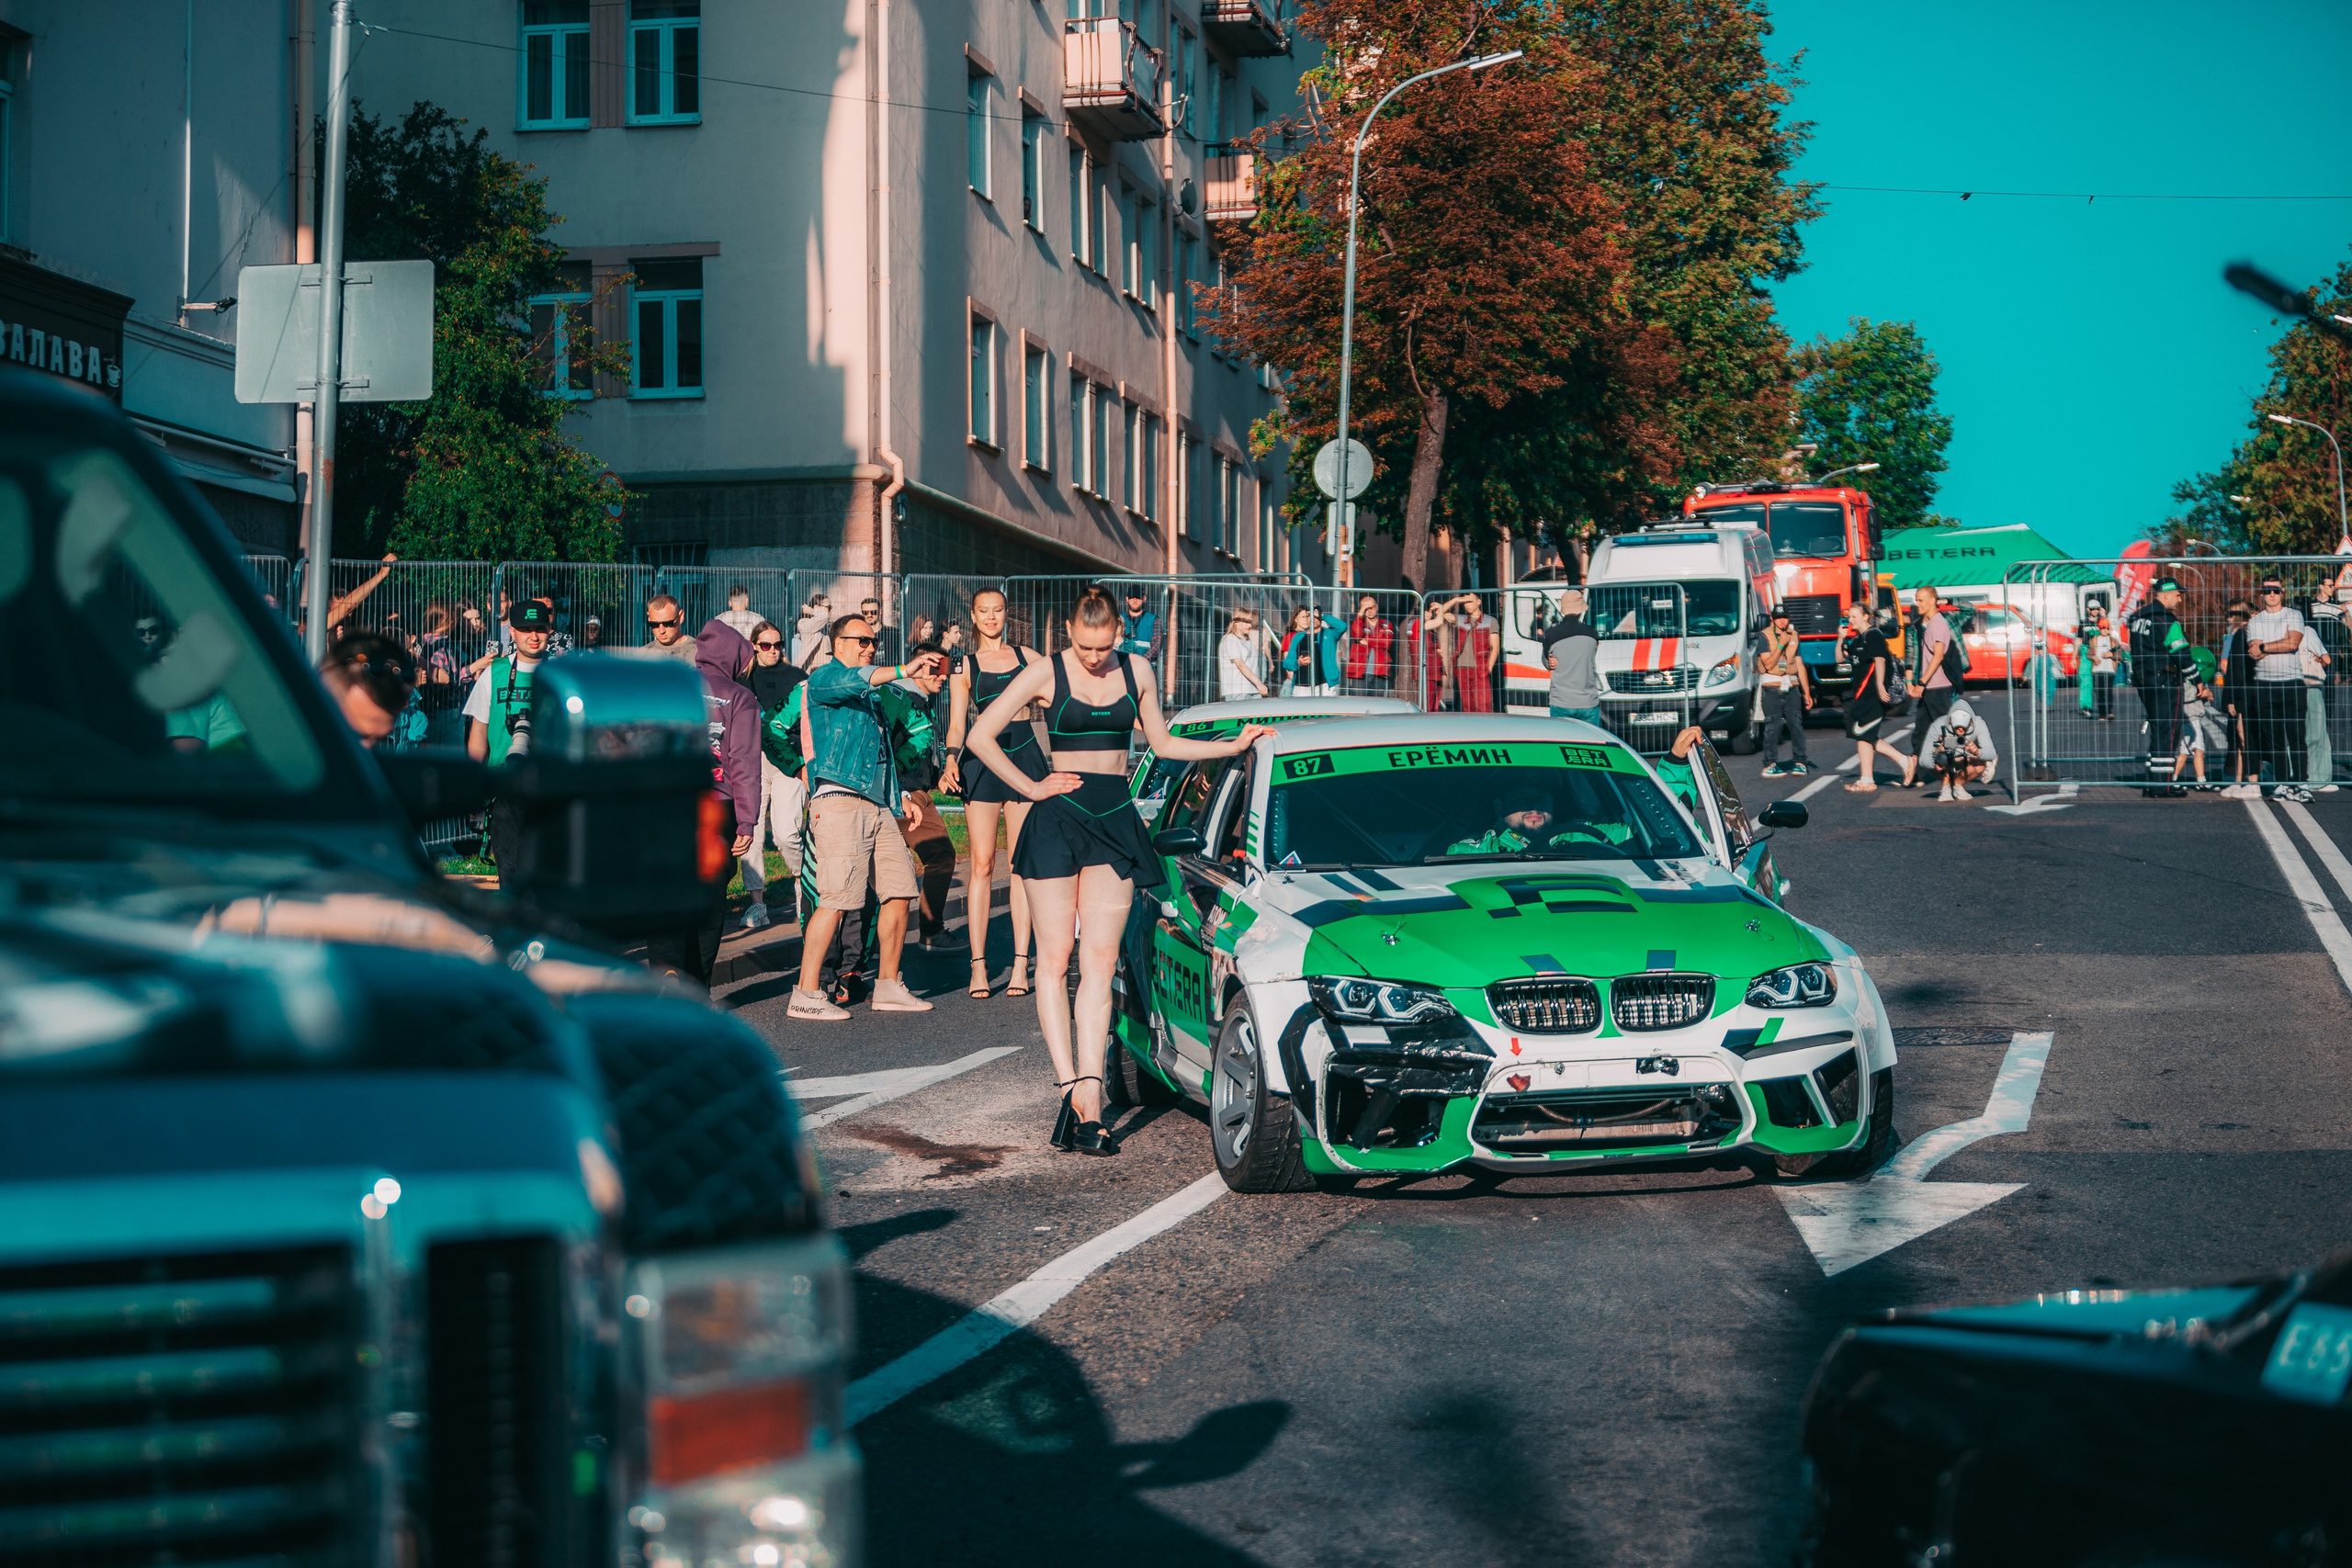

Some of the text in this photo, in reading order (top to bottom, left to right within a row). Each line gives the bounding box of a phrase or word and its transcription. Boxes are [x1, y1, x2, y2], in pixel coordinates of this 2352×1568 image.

[1186, 722, 1207, 733] 86
[1388, 746, 1513, 768] ЕРЁМИН
[1565, 748, 1601, 758] BET
[1293, 757, 1320, 776] 87
